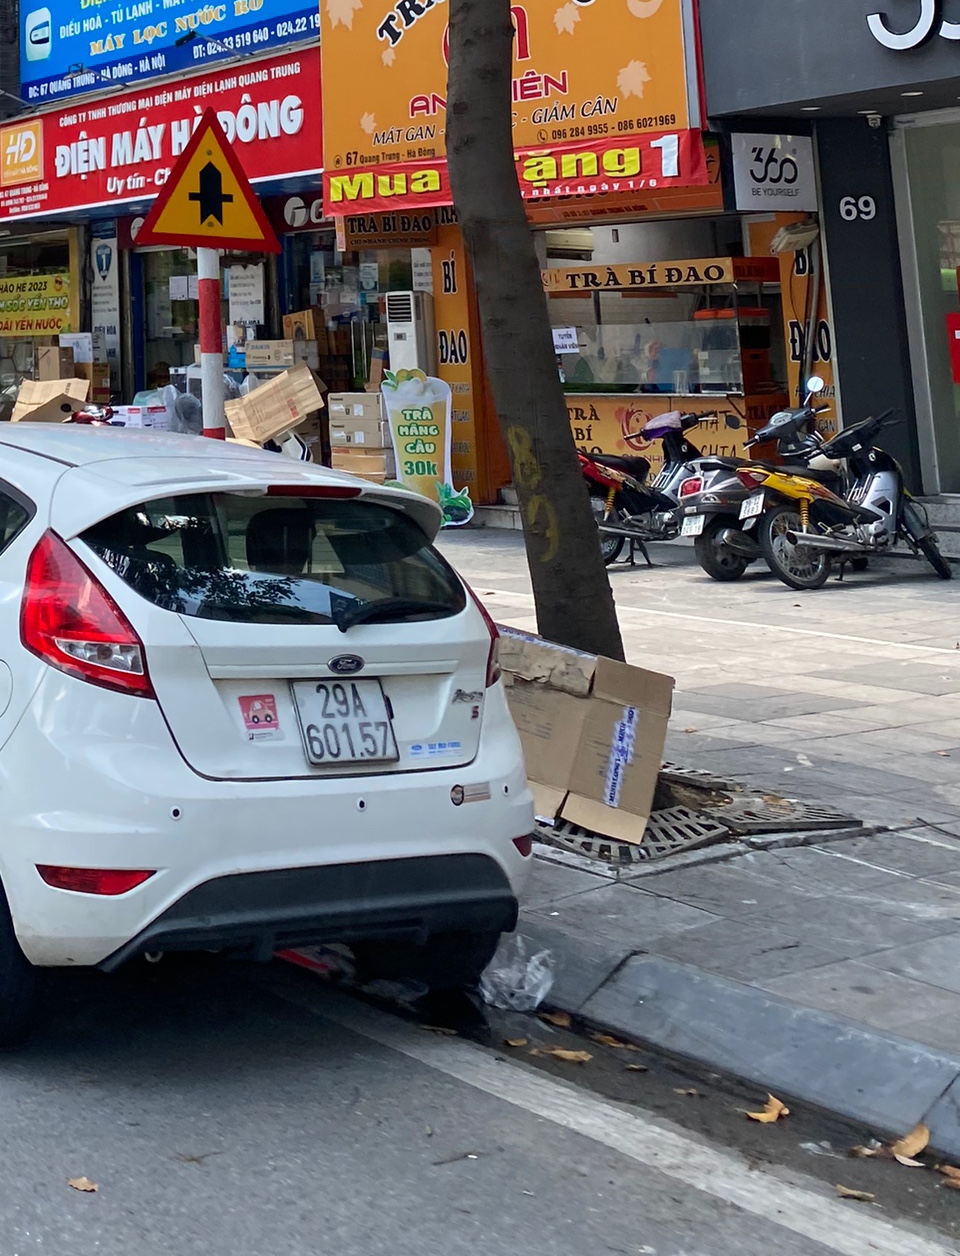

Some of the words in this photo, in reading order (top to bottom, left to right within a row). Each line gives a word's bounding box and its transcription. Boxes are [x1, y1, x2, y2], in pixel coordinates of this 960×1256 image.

[125, 0, 153, 23] LẠNH
[90, 31, 126, 56] MÁY
[132, 21, 168, 46] LỌC
[235, 31, 251, 49] 519
[59, 115, 77, 127] CÔNG
[78, 112, 87, 124] TY
[88, 108, 107, 121] TNHH
[138, 96, 153, 112] MẠI
[174, 85, 192, 101] MÁY
[214, 75, 237, 94] LẠNH
[238, 71, 269, 88] QUANG
[270, 61, 301, 80] TRUNG
[512, 70, 568, 103] IÊN
[532, 101, 576, 125] GIẢM
[580, 94, 619, 119] CÂN
[372, 126, 403, 147] MÁT
[405, 124, 436, 143] GAN
[551, 129, 567, 140] 096
[569, 127, 586, 138] 284
[587, 123, 609, 136] 9955
[617, 120, 634, 132] 086
[636, 114, 677, 129] 6021969
[54, 130, 107, 180] ĐIỆN
[111, 116, 167, 167] MÁY
[346, 151, 359, 166] 67
[359, 154, 380, 164] Quang
[381, 151, 400, 163] Trung
[406, 148, 417, 158] Hà
[329, 169, 441, 203] Mua
[515, 146, 642, 188] ặng
[649, 135, 679, 178] 1
[749, 146, 799, 184] 360
[106, 176, 124, 195] Uy
[126, 171, 146, 190] tín
[577, 180, 620, 194] ngày
[627, 178, 657, 189] 1/6
[751, 187, 761, 197] BE
[762, 187, 801, 197] YOURSELF
[839, 195, 877, 221] 69
[347, 212, 379, 234] TRÀ
[382, 211, 398, 233] BÍ
[400, 215, 432, 233] ĐAO
[441, 248, 458, 295] BÍ
[565, 266, 622, 289] TRÀ
[628, 264, 659, 285] BÍ
[664, 264, 725, 283] ĐAO
[27, 281, 48, 292] 2023
[438, 329, 468, 365] ĐAO
[788, 319, 832, 362] ĐO
[401, 406, 433, 421] TRÀ
[575, 425, 593, 441] BÍ
[403, 460, 437, 475] 30k
[315, 683, 367, 719] 29A
[306, 721, 389, 760] 601.57
